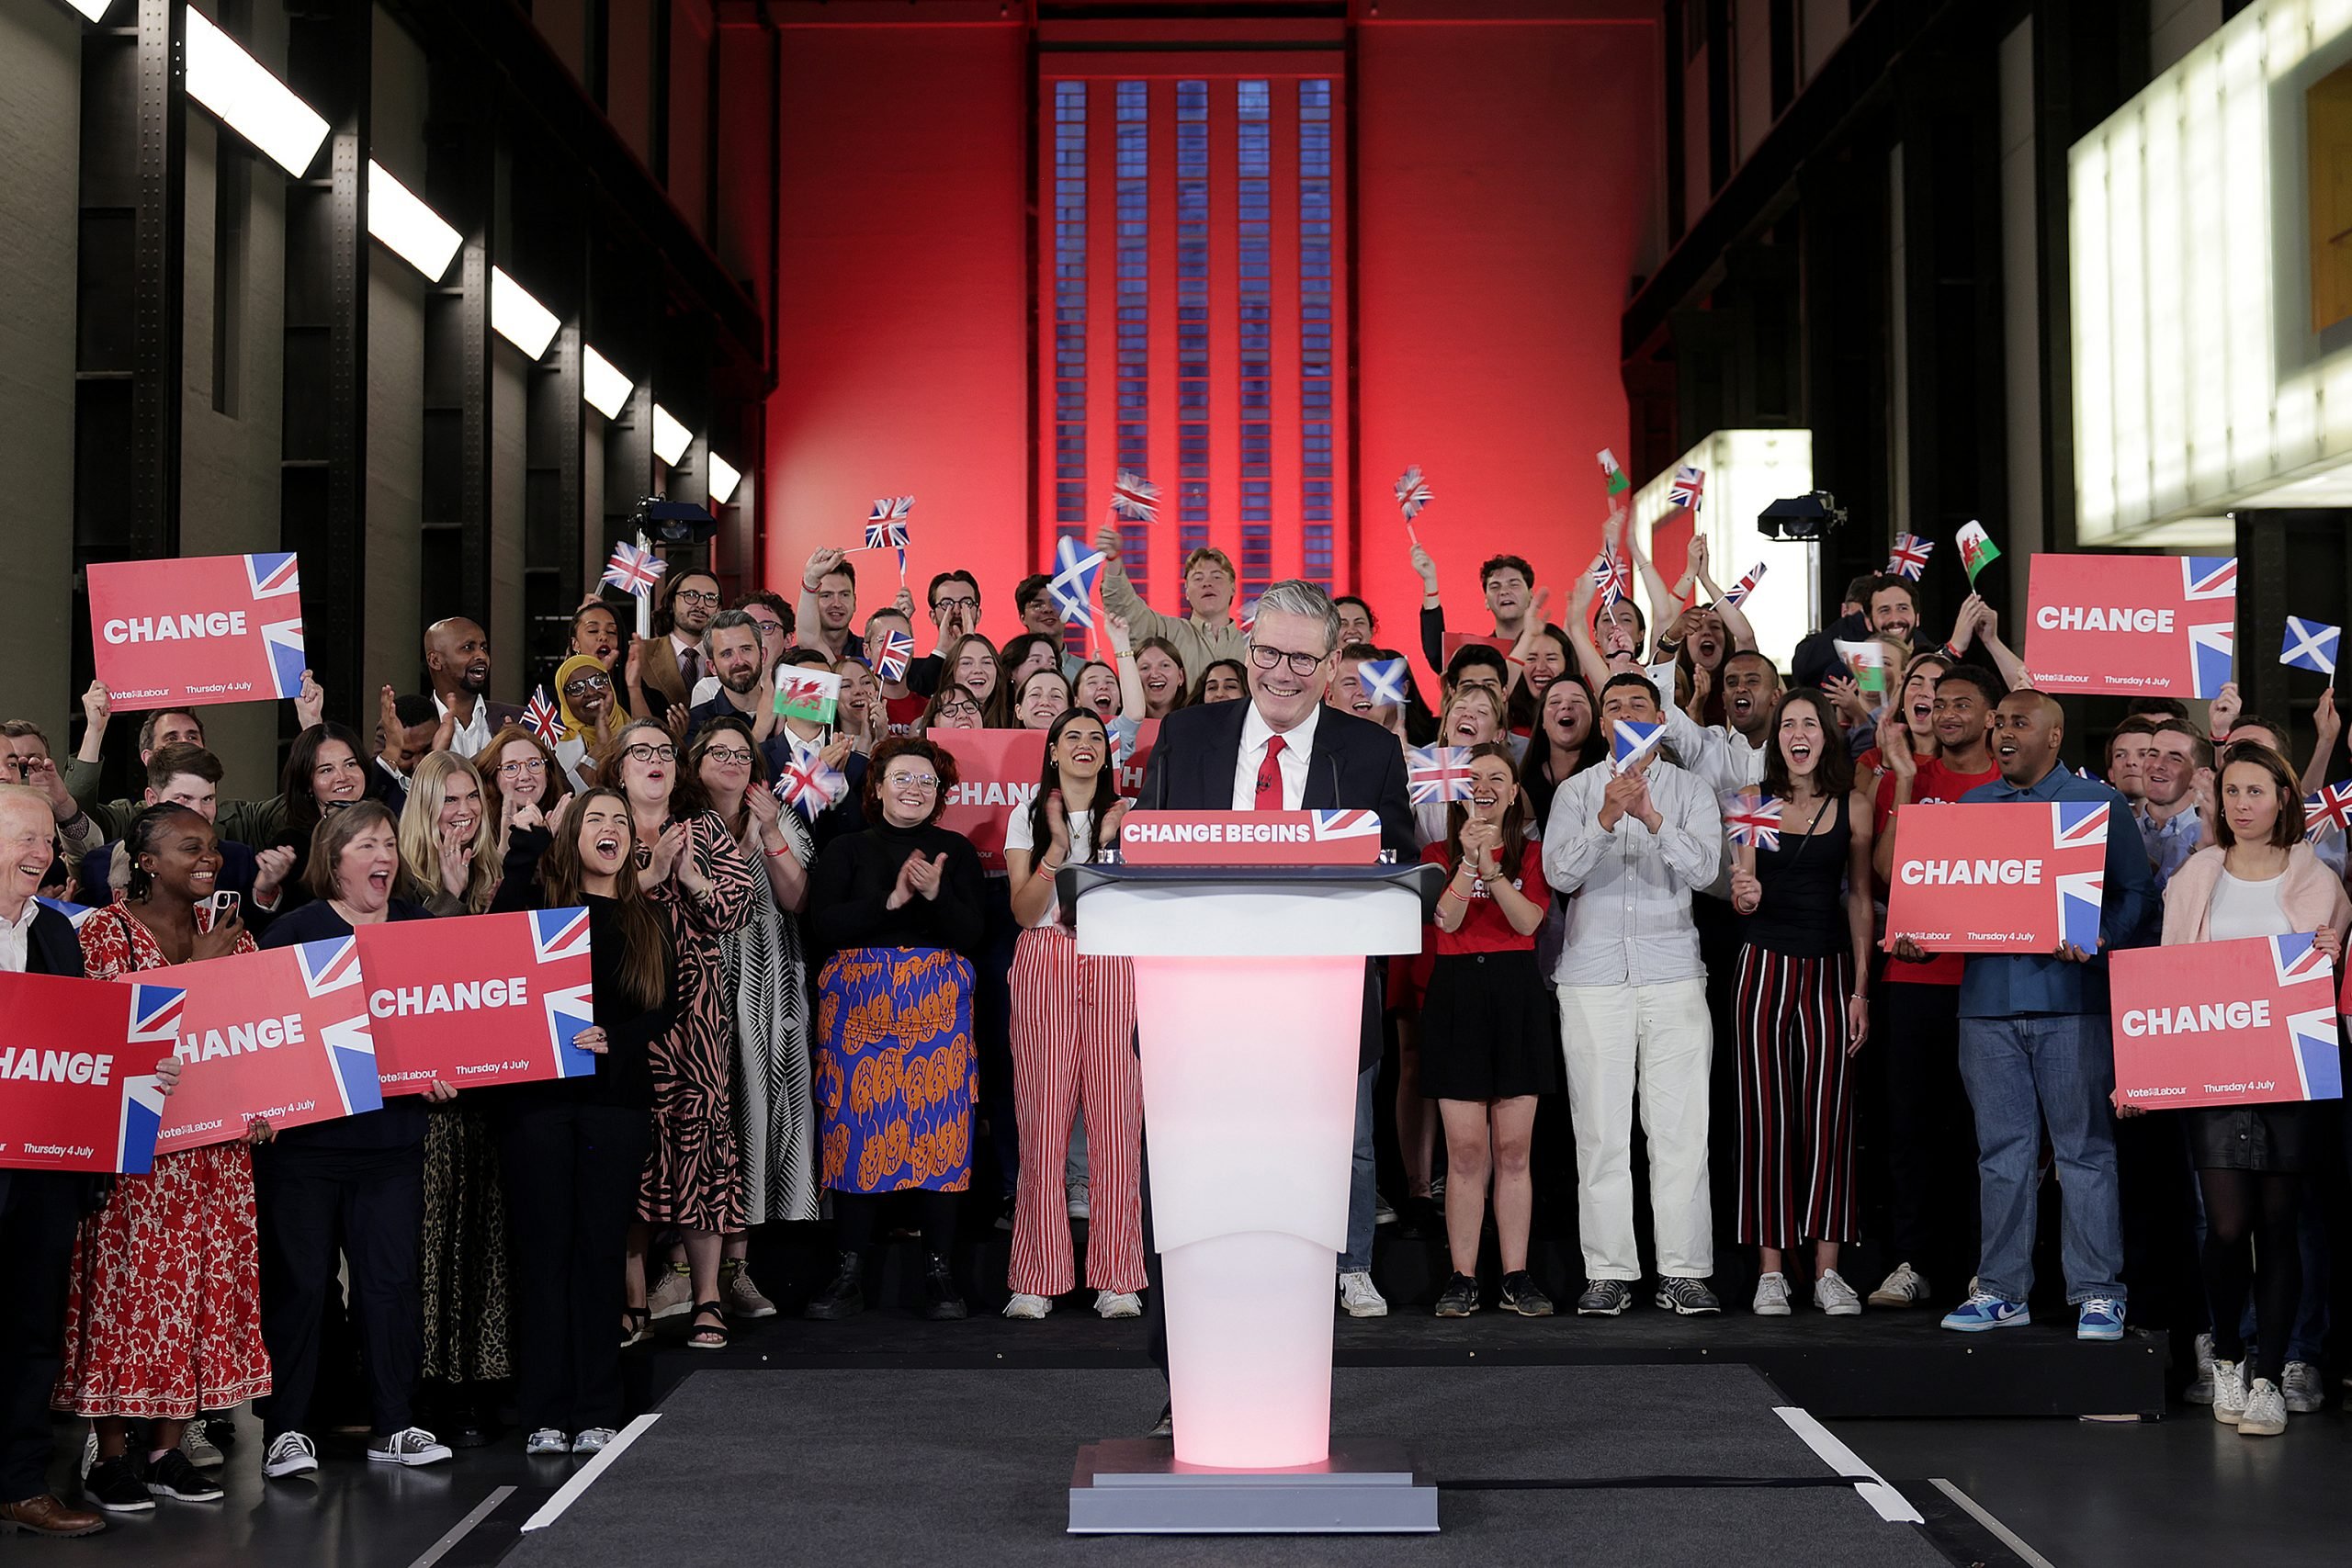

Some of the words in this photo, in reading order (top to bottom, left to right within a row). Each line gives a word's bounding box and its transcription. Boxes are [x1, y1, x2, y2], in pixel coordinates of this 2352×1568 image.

[2036, 605, 2175, 633] CHANGE
[103, 610, 248, 644] CHANGE
[2033, 673, 2053, 682] Vote
[2061, 674, 2088, 682] Labour
[2104, 675, 2144, 686] Thursday
[2144, 677, 2152, 685] 4
[2152, 676, 2170, 688] July
[109, 690, 132, 700] Vote
[140, 688, 170, 698] Labour
[186, 683, 227, 694] Thursday
[227, 682, 233, 691] 4
[234, 682, 253, 692] July
[1124, 824, 1222, 843] CHANGE
[1226, 824, 1311, 843] BEGINS
[1901, 859, 2043, 886] CHANGE
[1922, 931, 1951, 941] Labour
[1967, 931, 2008, 942] Thursday
[2008, 932, 2016, 941] 4
[2016, 931, 2036, 942] July
[369, 976, 528, 1019] CHANGE
[2121, 998, 2271, 1037] CHANGE
[173, 1013, 305, 1066] HANGE
[0, 1046, 114, 1086] HANGE
[456, 1061, 501, 1075] Thursday
[502, 1060, 509, 1070] 4
[509, 1059, 530, 1071] July
[405, 1069, 437, 1080] Labour
[2126, 1089, 2149, 1098] Vote
[2156, 1087, 2187, 1096] Labour
[2203, 1083, 2247, 1093] Thursday
[2247, 1082, 2255, 1090] 4
[2256, 1080, 2275, 1092] July
[288, 1103, 295, 1112] 4
[296, 1100, 316, 1111] July
[189, 1119, 223, 1133] Labour
[24, 1143, 66, 1157] Thursday
[66, 1145, 74, 1155] 4
[74, 1145, 94, 1159] July
